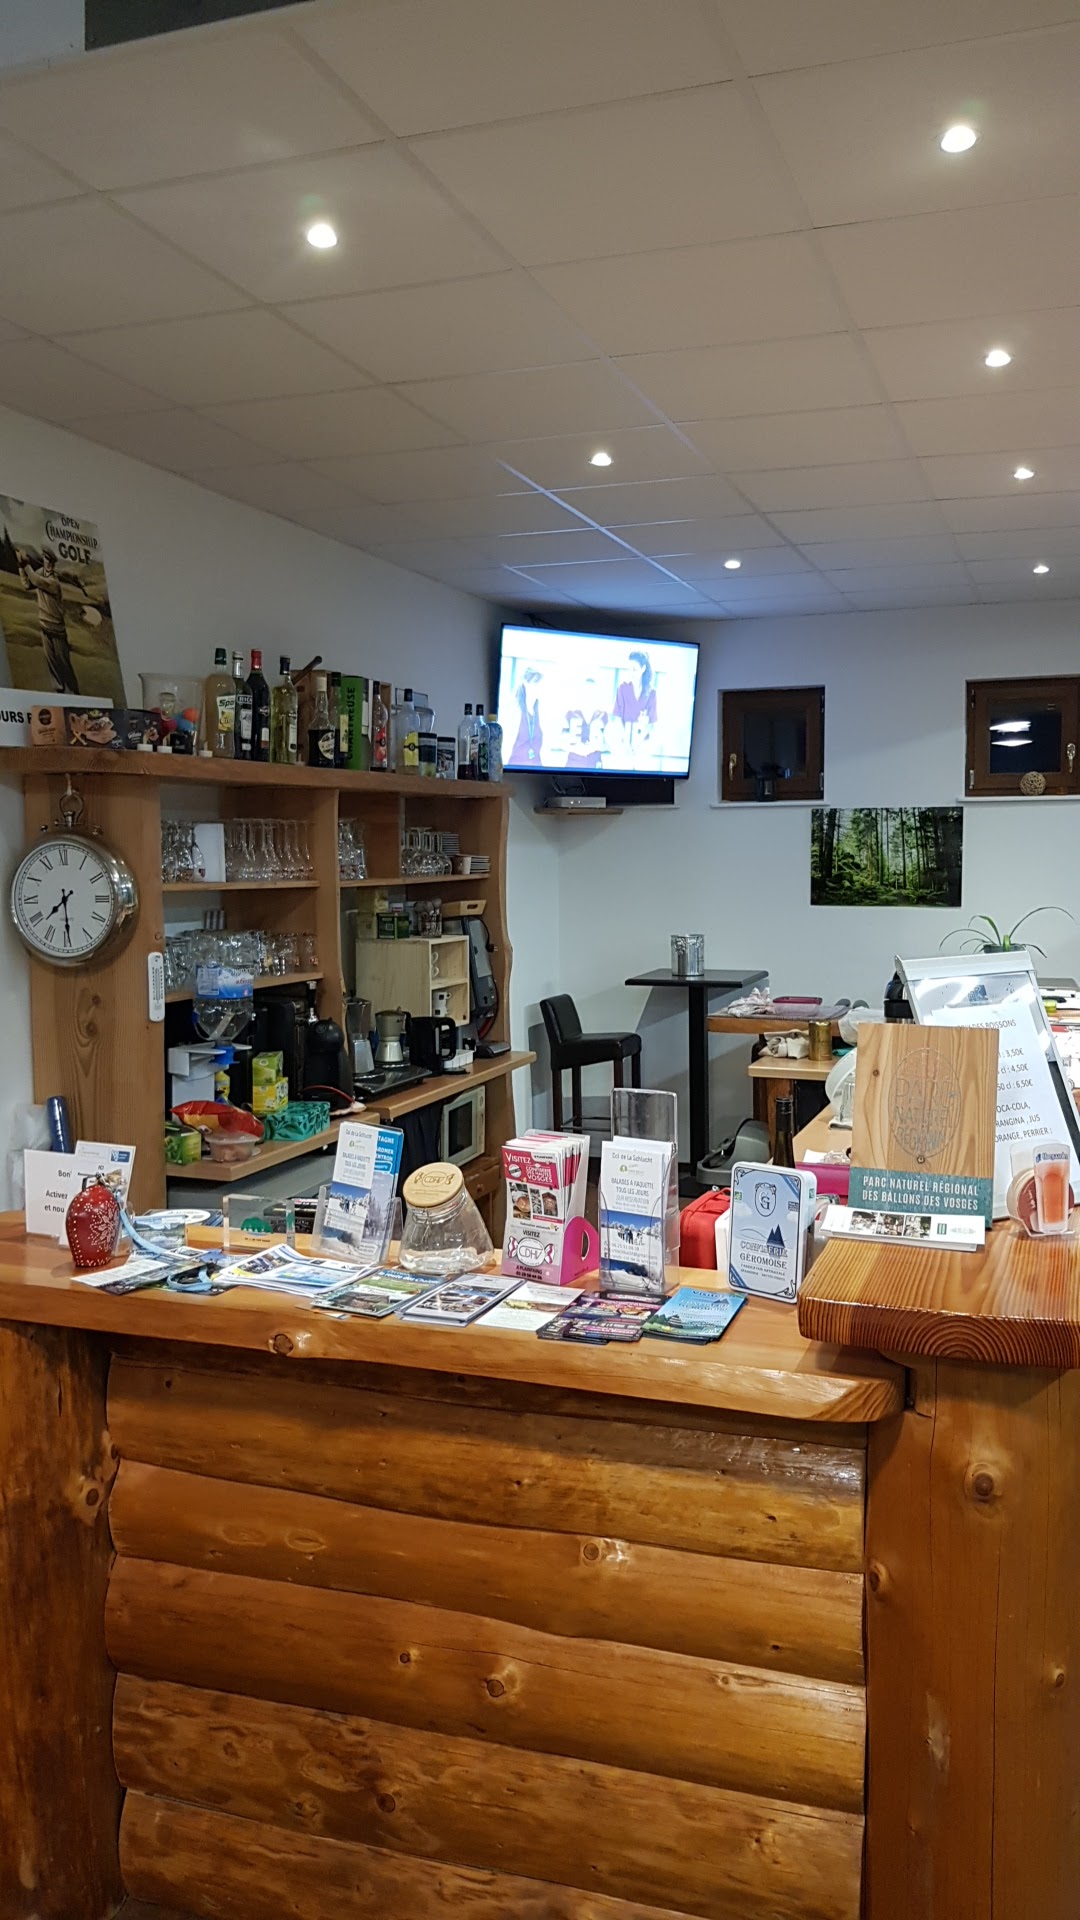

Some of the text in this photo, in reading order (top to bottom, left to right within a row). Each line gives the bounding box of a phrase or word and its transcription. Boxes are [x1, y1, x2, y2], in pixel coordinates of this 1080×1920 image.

[62, 517, 80, 530] OPEN
[46, 521, 98, 549] CHAMPIONSHIP
[59, 543, 91, 565] GOLF
[985, 1019, 1017, 1029] BOISSONS
[1006, 1048, 1024, 1058] 3,50€
[1011, 1063, 1029, 1073] 4,50€
[1006, 1081, 1012, 1089] cl
[1016, 1079, 1033, 1088] 6,50€
[1029, 1114, 1041, 1123] JUS
[1023, 1126, 1049, 1138] PERRIER
[505, 1152, 532, 1164] VISITEZ
[633, 1155, 653, 1163] Schlucht
[58, 1169, 73, 1178] Bon
[527, 1173, 553, 1183] VOSGES
[863, 1175, 979, 1196] PARC NATUREL RÉGIONAL
[46, 1190, 68, 1200] Activez
[862, 1189, 979, 1211] DES BALLONS DES VOSGES
[523, 1230, 541, 1238] VISITEZ
[740, 1252, 788, 1270] GÉROMOISE
